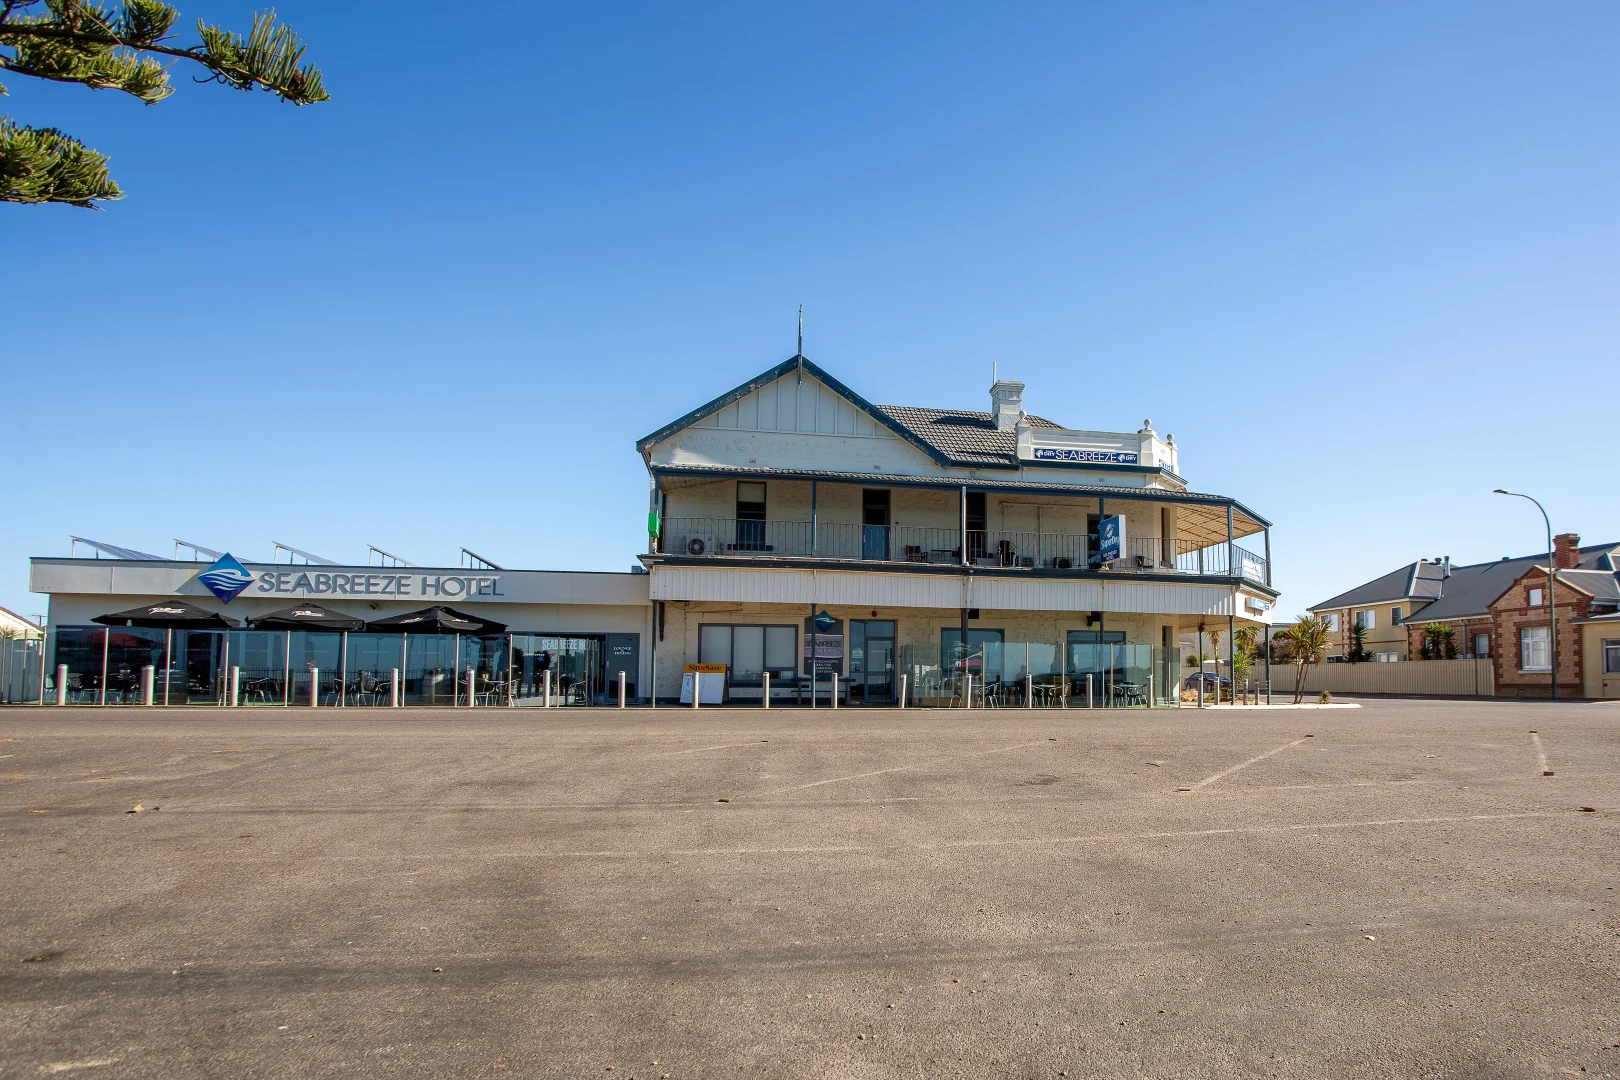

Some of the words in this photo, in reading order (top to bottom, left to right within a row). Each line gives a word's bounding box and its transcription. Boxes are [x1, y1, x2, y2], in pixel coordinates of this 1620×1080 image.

[1055, 450, 1117, 463] SEABREEZE
[257, 571, 412, 596] SEABREEZE
[421, 576, 505, 597] HOTEL
[541, 638, 577, 650] SEABREEZE
